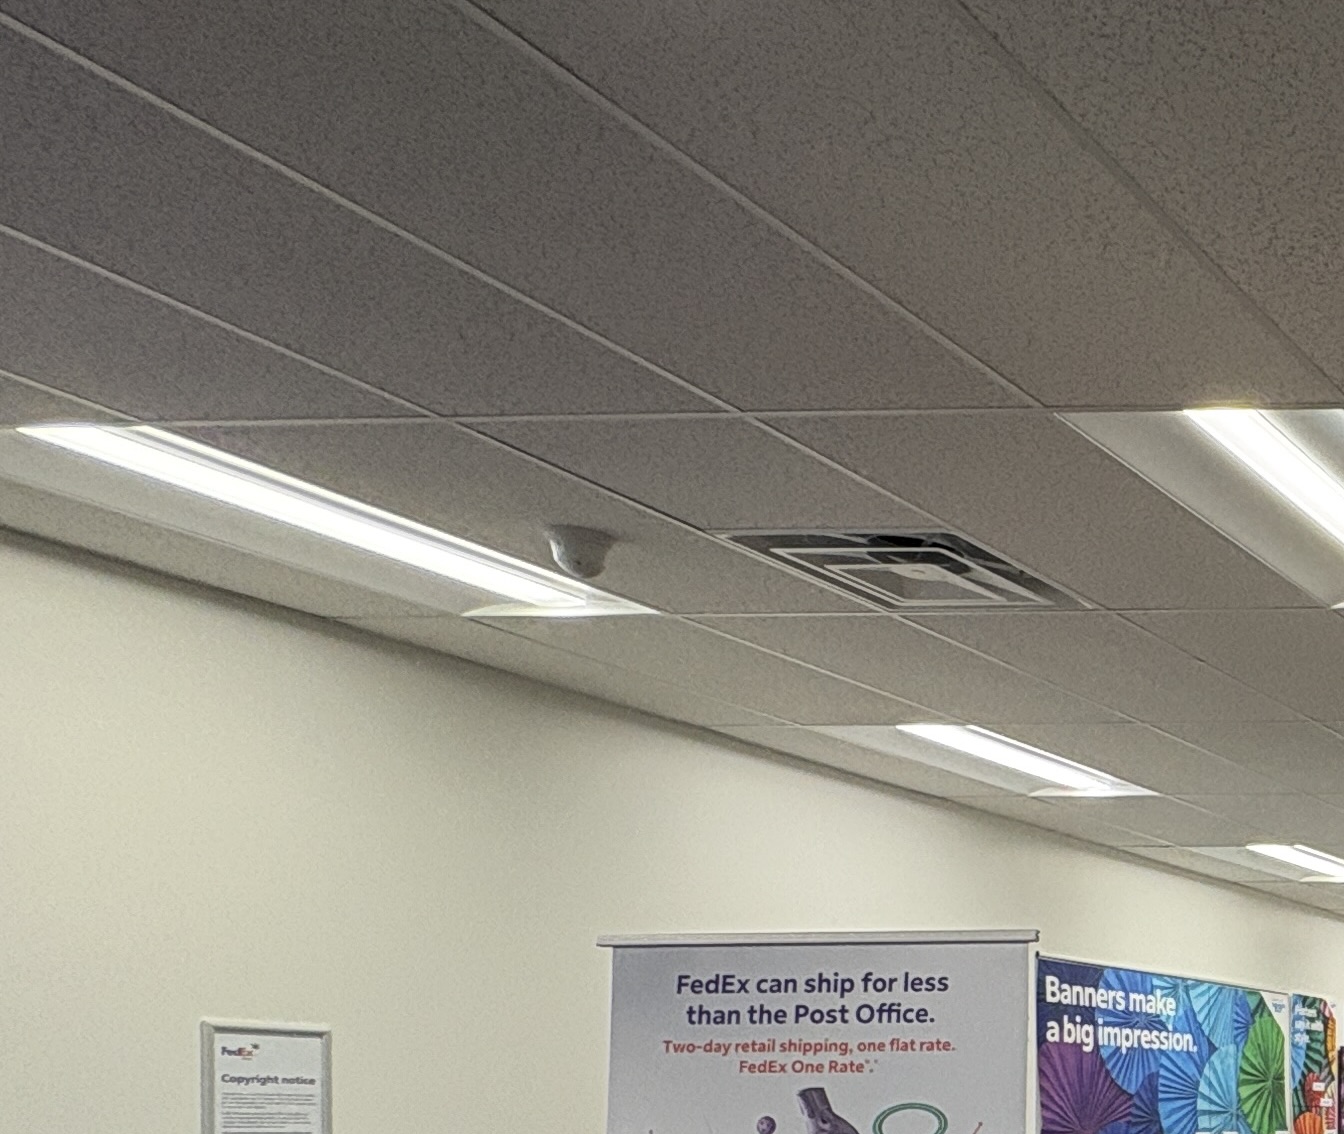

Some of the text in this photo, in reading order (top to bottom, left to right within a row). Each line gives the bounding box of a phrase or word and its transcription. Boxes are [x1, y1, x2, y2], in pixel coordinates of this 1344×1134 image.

[676, 972, 949, 999] FedEx can ship for less
[1045, 974, 1176, 1017] Banners make
[686, 1003, 935, 1026] than the Post Office.
[1045, 1016, 1198, 1053] a big impression.
[663, 1037, 956, 1057] Two-day retail shipping, one flat rate.
[739, 1060, 825, 1074] FedEx One
[221, 1074, 316, 1086] Copyright notice
